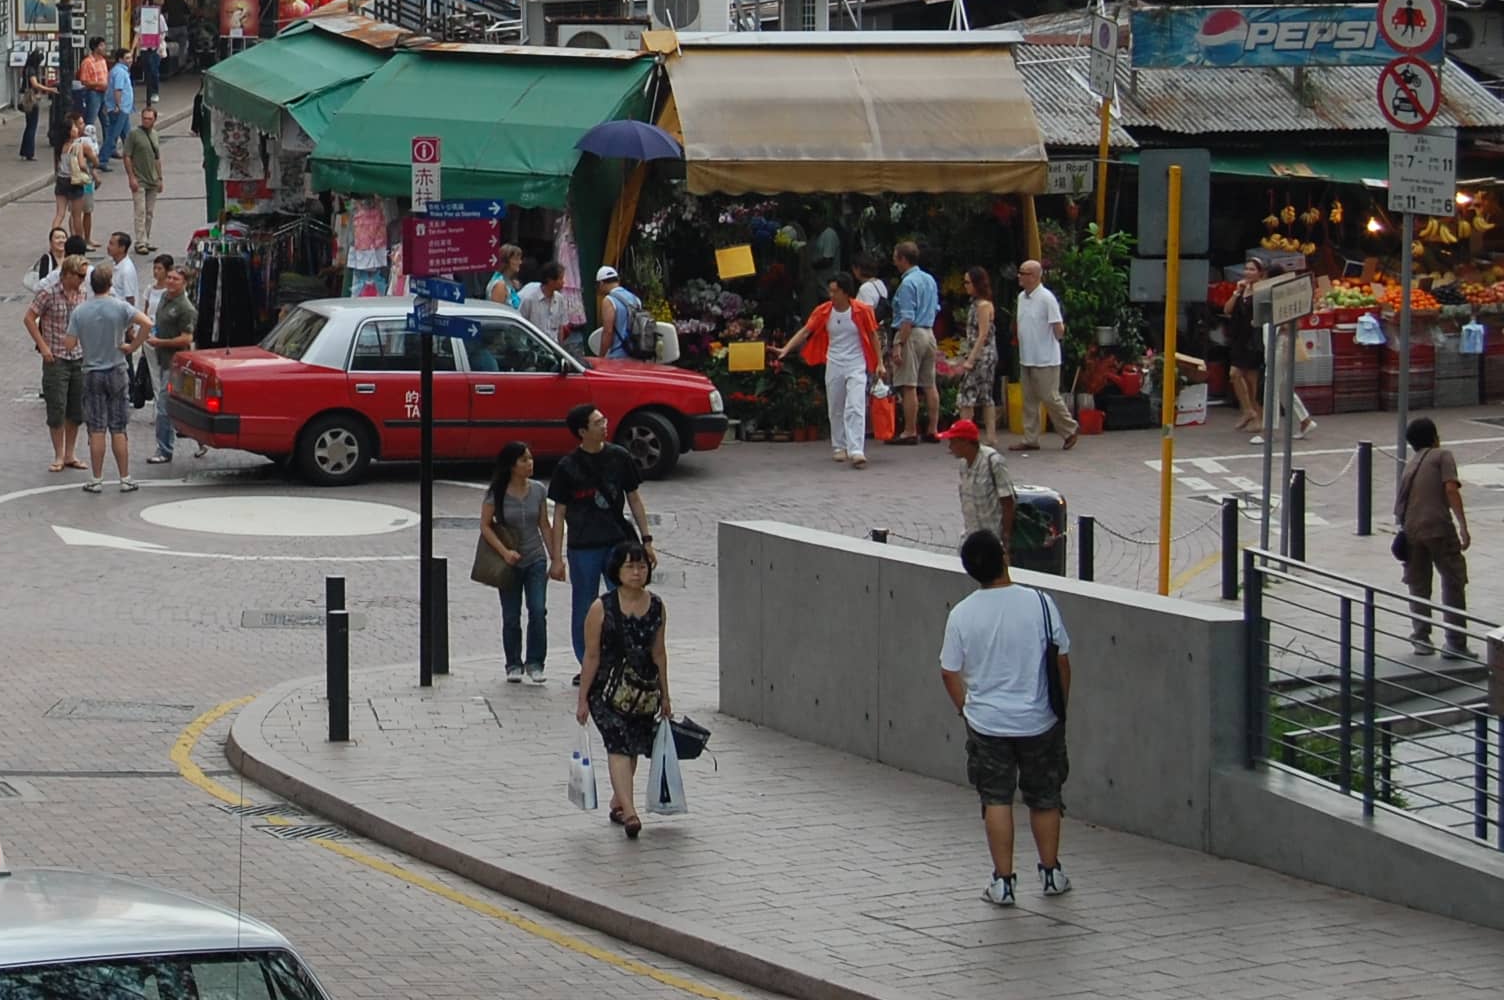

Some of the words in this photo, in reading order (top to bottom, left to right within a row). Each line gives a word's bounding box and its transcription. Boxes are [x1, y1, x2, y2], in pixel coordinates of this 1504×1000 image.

[1244, 21, 1377, 51] PEPSI
[1066, 162, 1088, 173] Road
[1407, 154, 1415, 169] 7
[1442, 157, 1453, 172] 11
[1406, 194, 1417, 210] 11
[1444, 198, 1454, 213] 6
